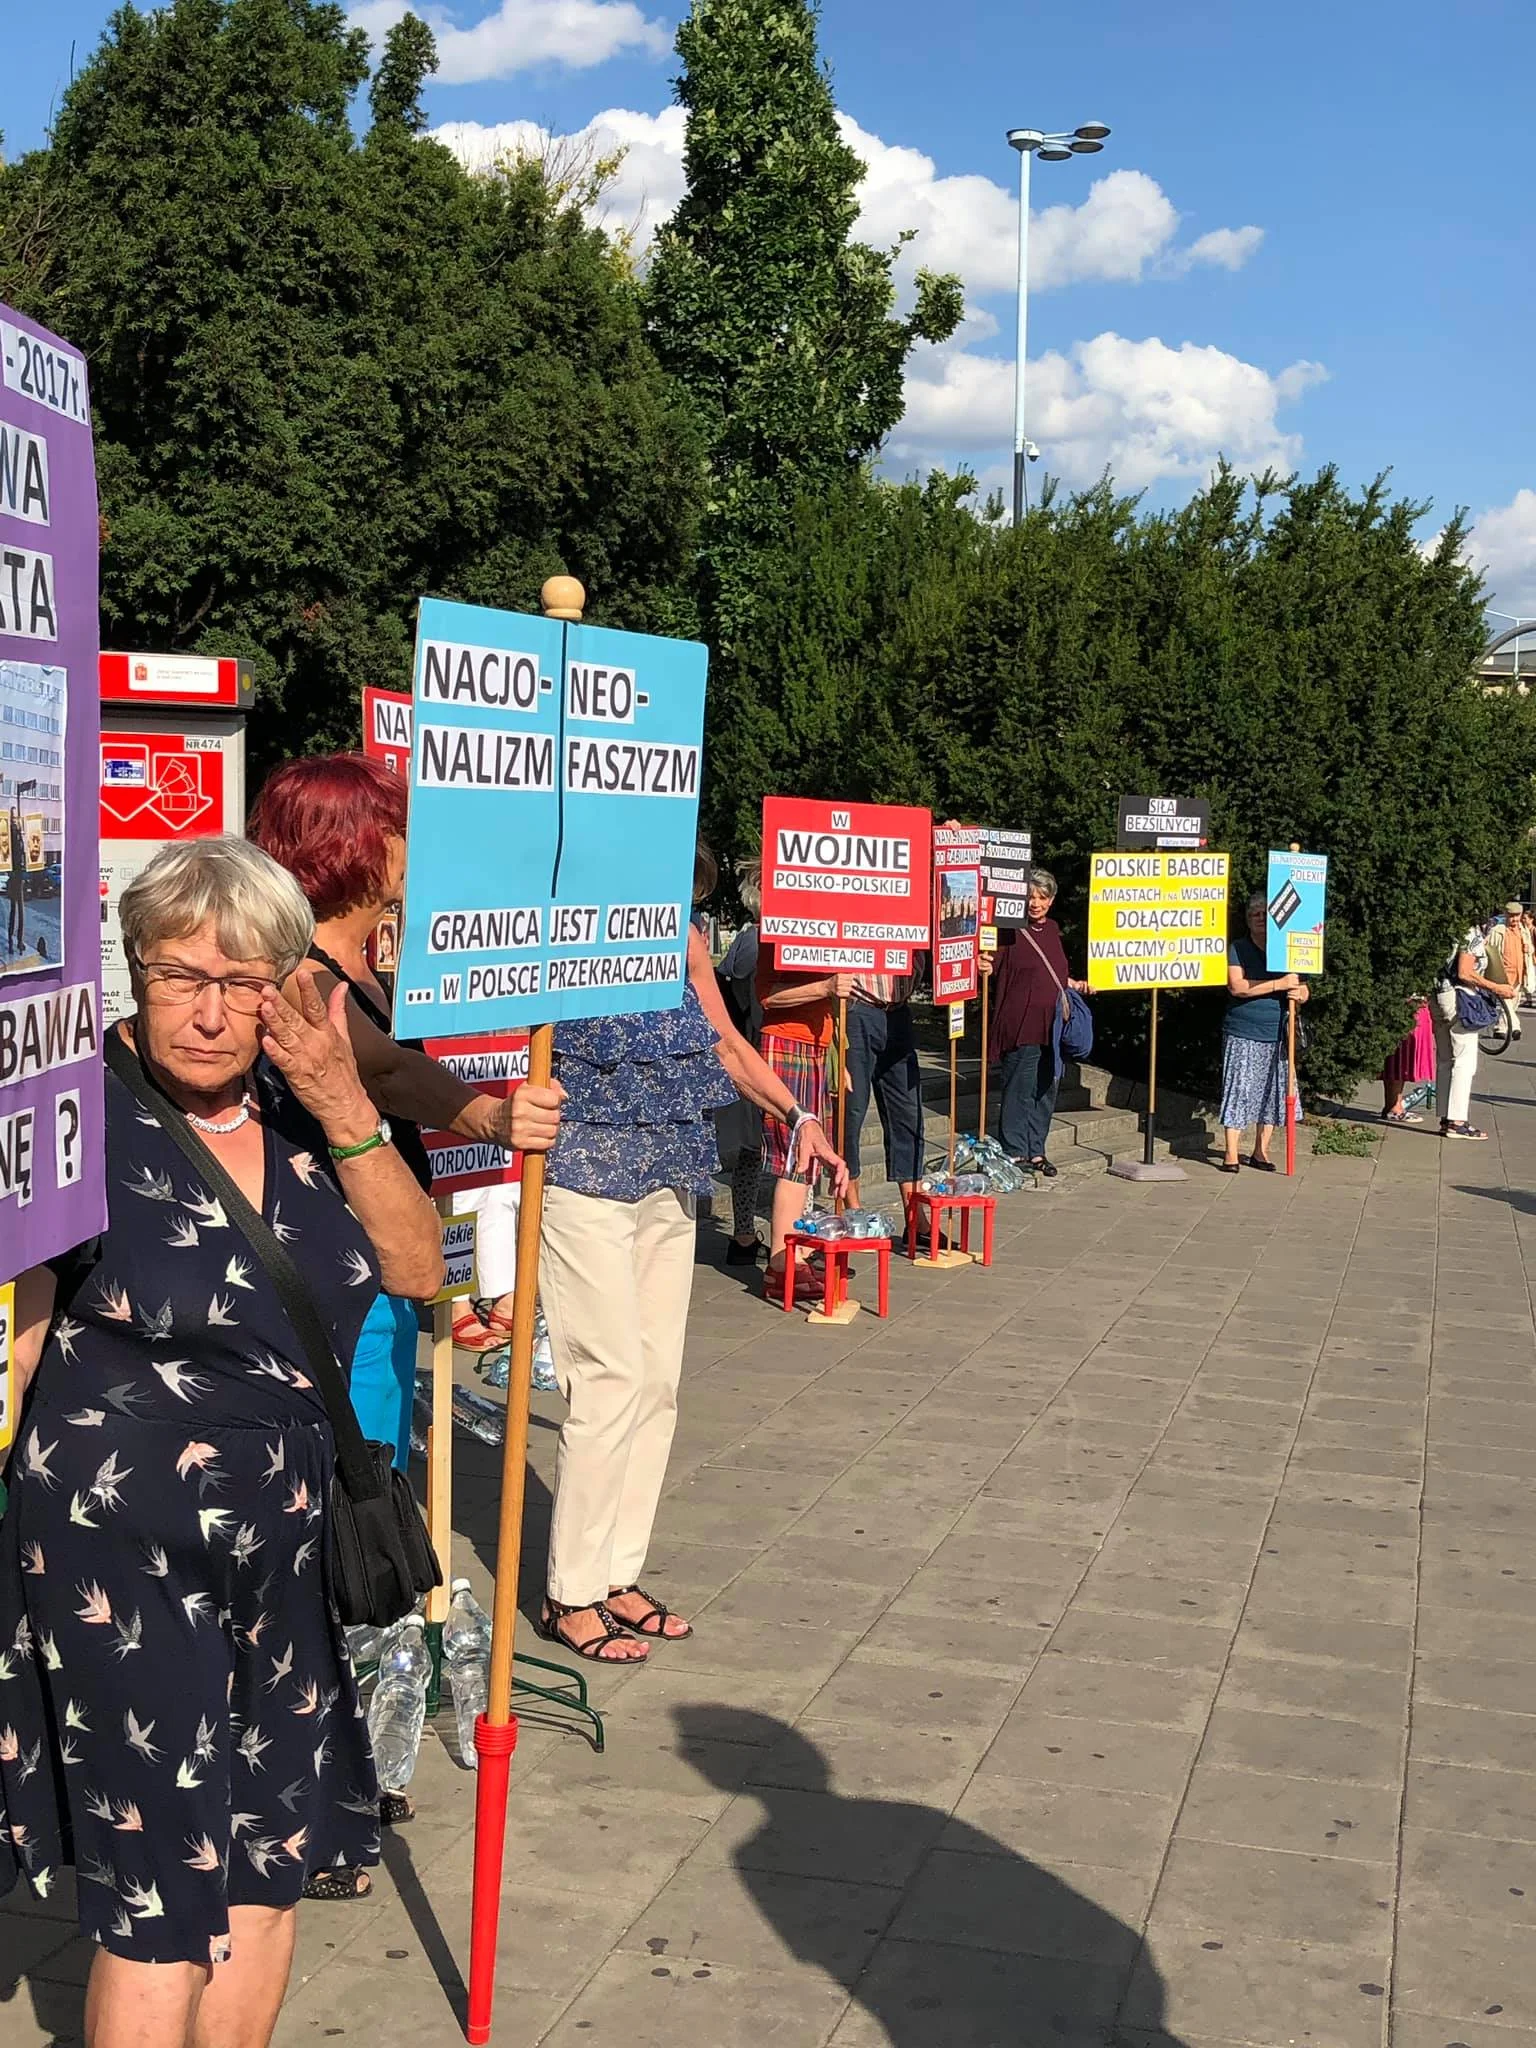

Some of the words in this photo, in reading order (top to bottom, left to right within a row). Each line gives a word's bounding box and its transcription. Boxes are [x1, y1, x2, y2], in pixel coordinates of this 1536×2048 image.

[0, 551, 56, 637] TA
[424, 646, 552, 707] NACJO-
[571, 666, 649, 718] NEO-
[377, 703, 412, 744] NA
[421, 729, 553, 786] NALIZM
[567, 741, 697, 793] FASZYZM
[1150, 800, 1175, 814] SIŁA
[1127, 816, 1199, 831] BEZSILNYCH
[779, 832, 909, 870] WOJNIE
[1094, 858, 1161, 877] POLSKIE
[1167, 857, 1225, 876] BABCIE
[1290, 870, 1325, 882] POLEXIT
[776, 873, 909, 894] POLSKO-POLSKIEJ
[1102, 888, 1160, 901] MIASTACH
[1181, 887, 1225, 900] WSIACH
[997, 900, 1024, 916] STOP
[430, 909, 540, 952] GRANICA
[550, 906, 597, 944] JEST
[607, 905, 678, 941] CIENKA
[764, 918, 837, 937] WSZYSCY
[843, 924, 927, 940] PRZEGRAMY
[1115, 910, 1203, 932] DOŁĄCZCIE
[782, 947, 873, 966] OPAMIĘTAJCIE
[886, 951, 907, 967] SIĘ
[1090, 941, 1166, 958] WALCZMY
[1178, 938, 1225, 954] JUTRO
[469, 965, 540, 999] POLSCE
[547, 954, 678, 990] PRZEKRACZANA
[1115, 957, 1201, 983] WNUKÓW
